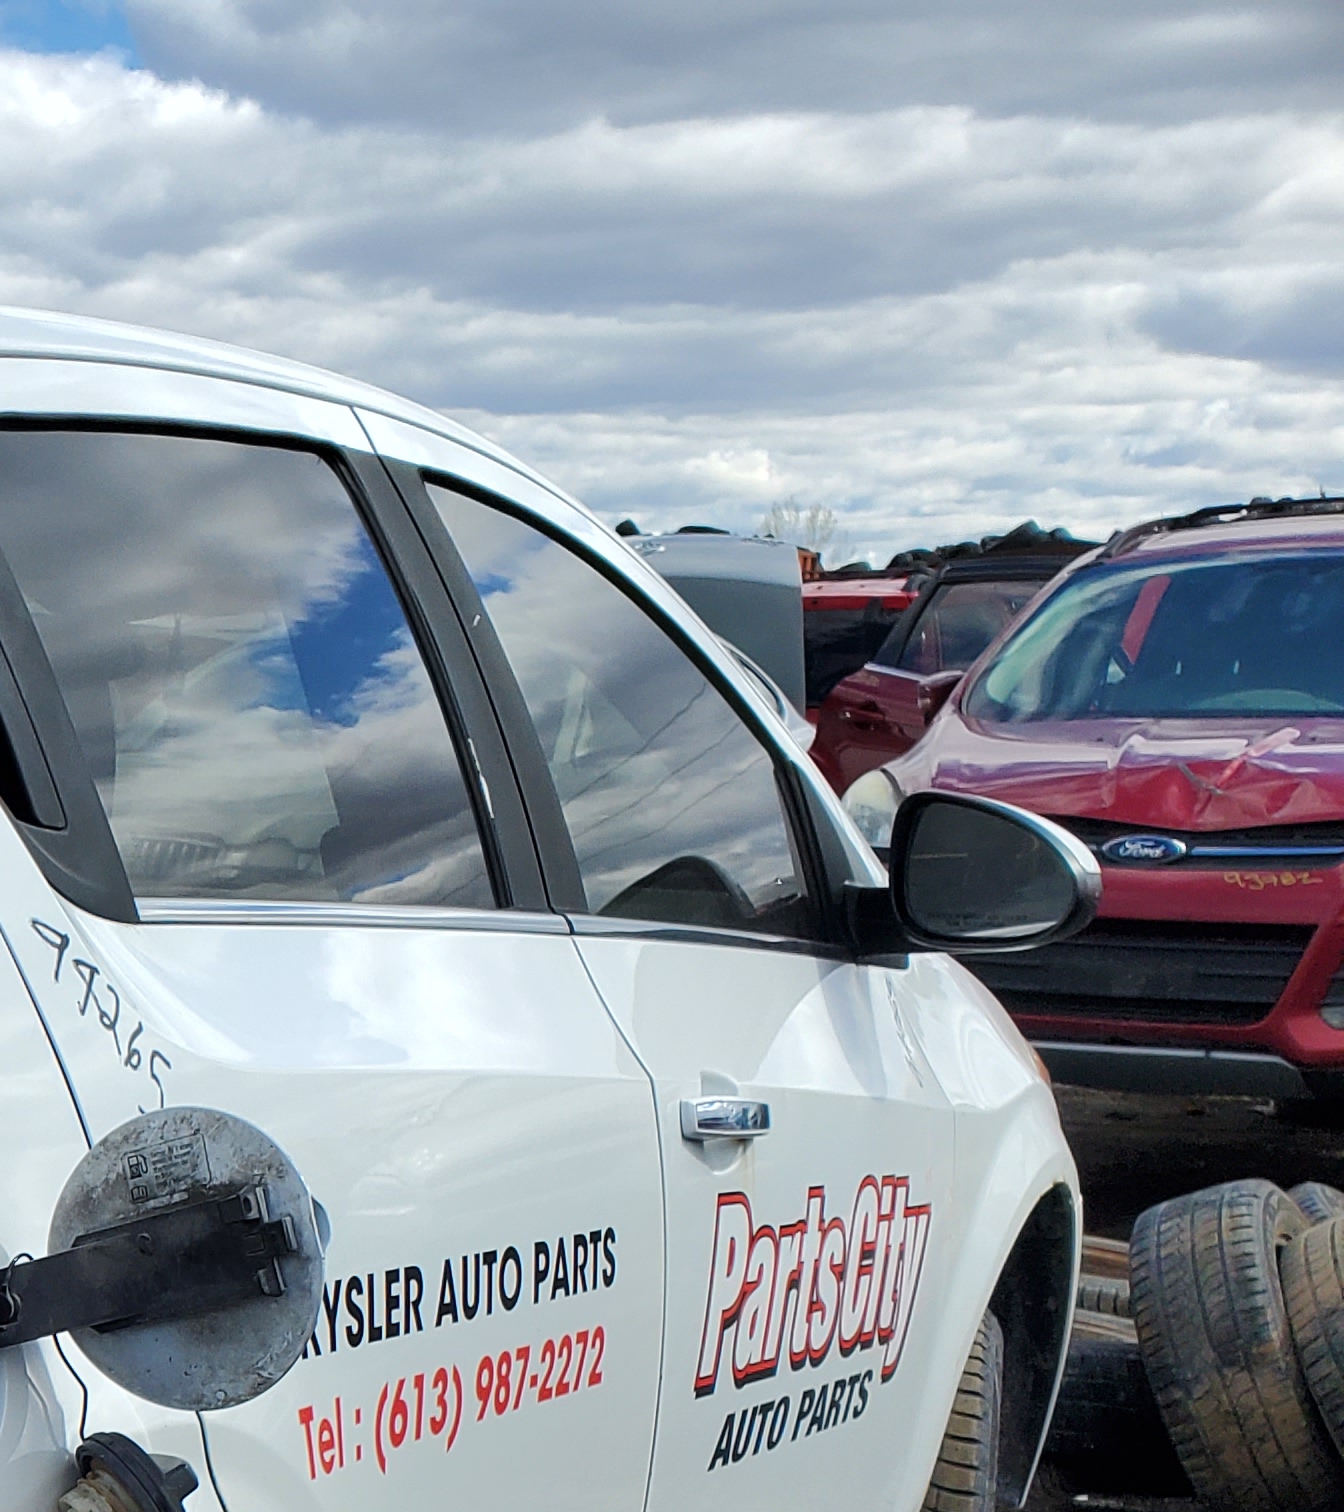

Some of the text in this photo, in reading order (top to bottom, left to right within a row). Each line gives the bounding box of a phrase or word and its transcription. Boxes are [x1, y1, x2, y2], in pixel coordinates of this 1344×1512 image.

[434, 1244, 524, 1328] AUTO
[532, 1226, 618, 1306] PARTS
[373, 1364, 464, 1476] (613)
[474, 1325, 607, 1424] 987-2272
[706, 1368, 875, 1473] AUTO PARTS
